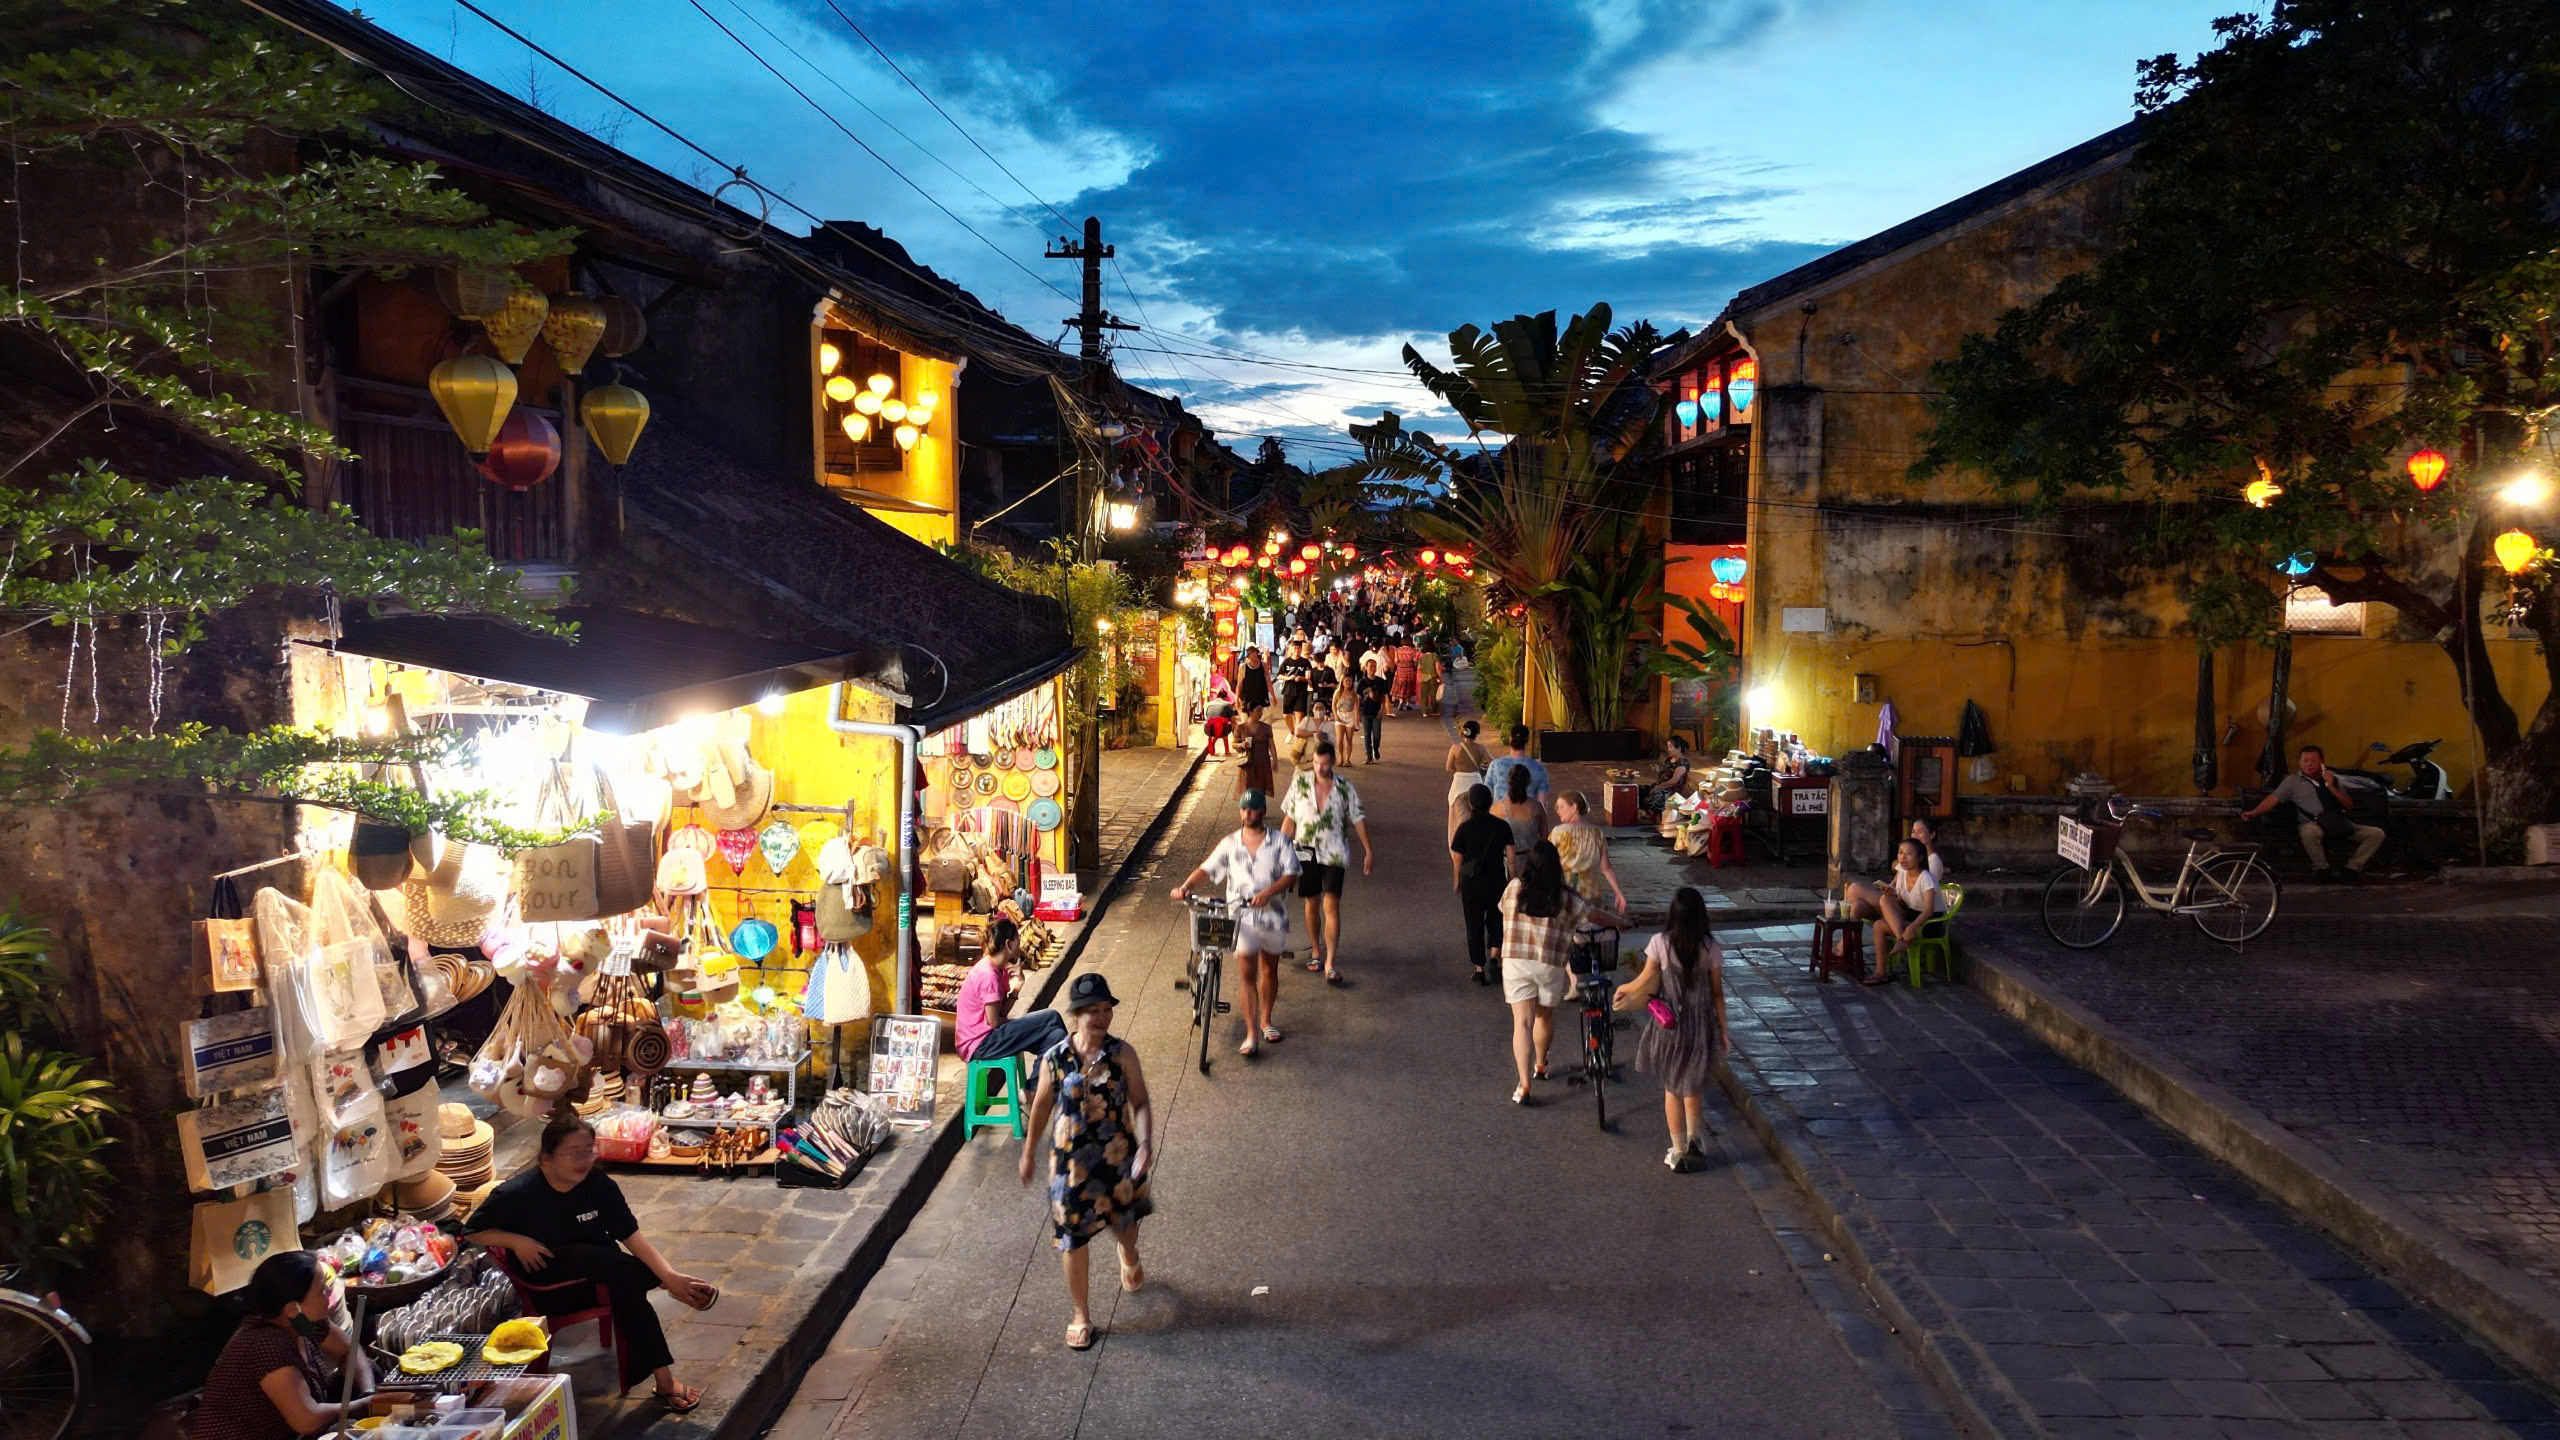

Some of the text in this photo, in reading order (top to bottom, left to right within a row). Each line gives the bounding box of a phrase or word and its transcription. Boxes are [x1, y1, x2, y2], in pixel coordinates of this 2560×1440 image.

[1042, 879, 1075, 890] SLEEPING BAG
[234, 1044, 253, 1055] NAM
[247, 1130, 268, 1142] NAM
